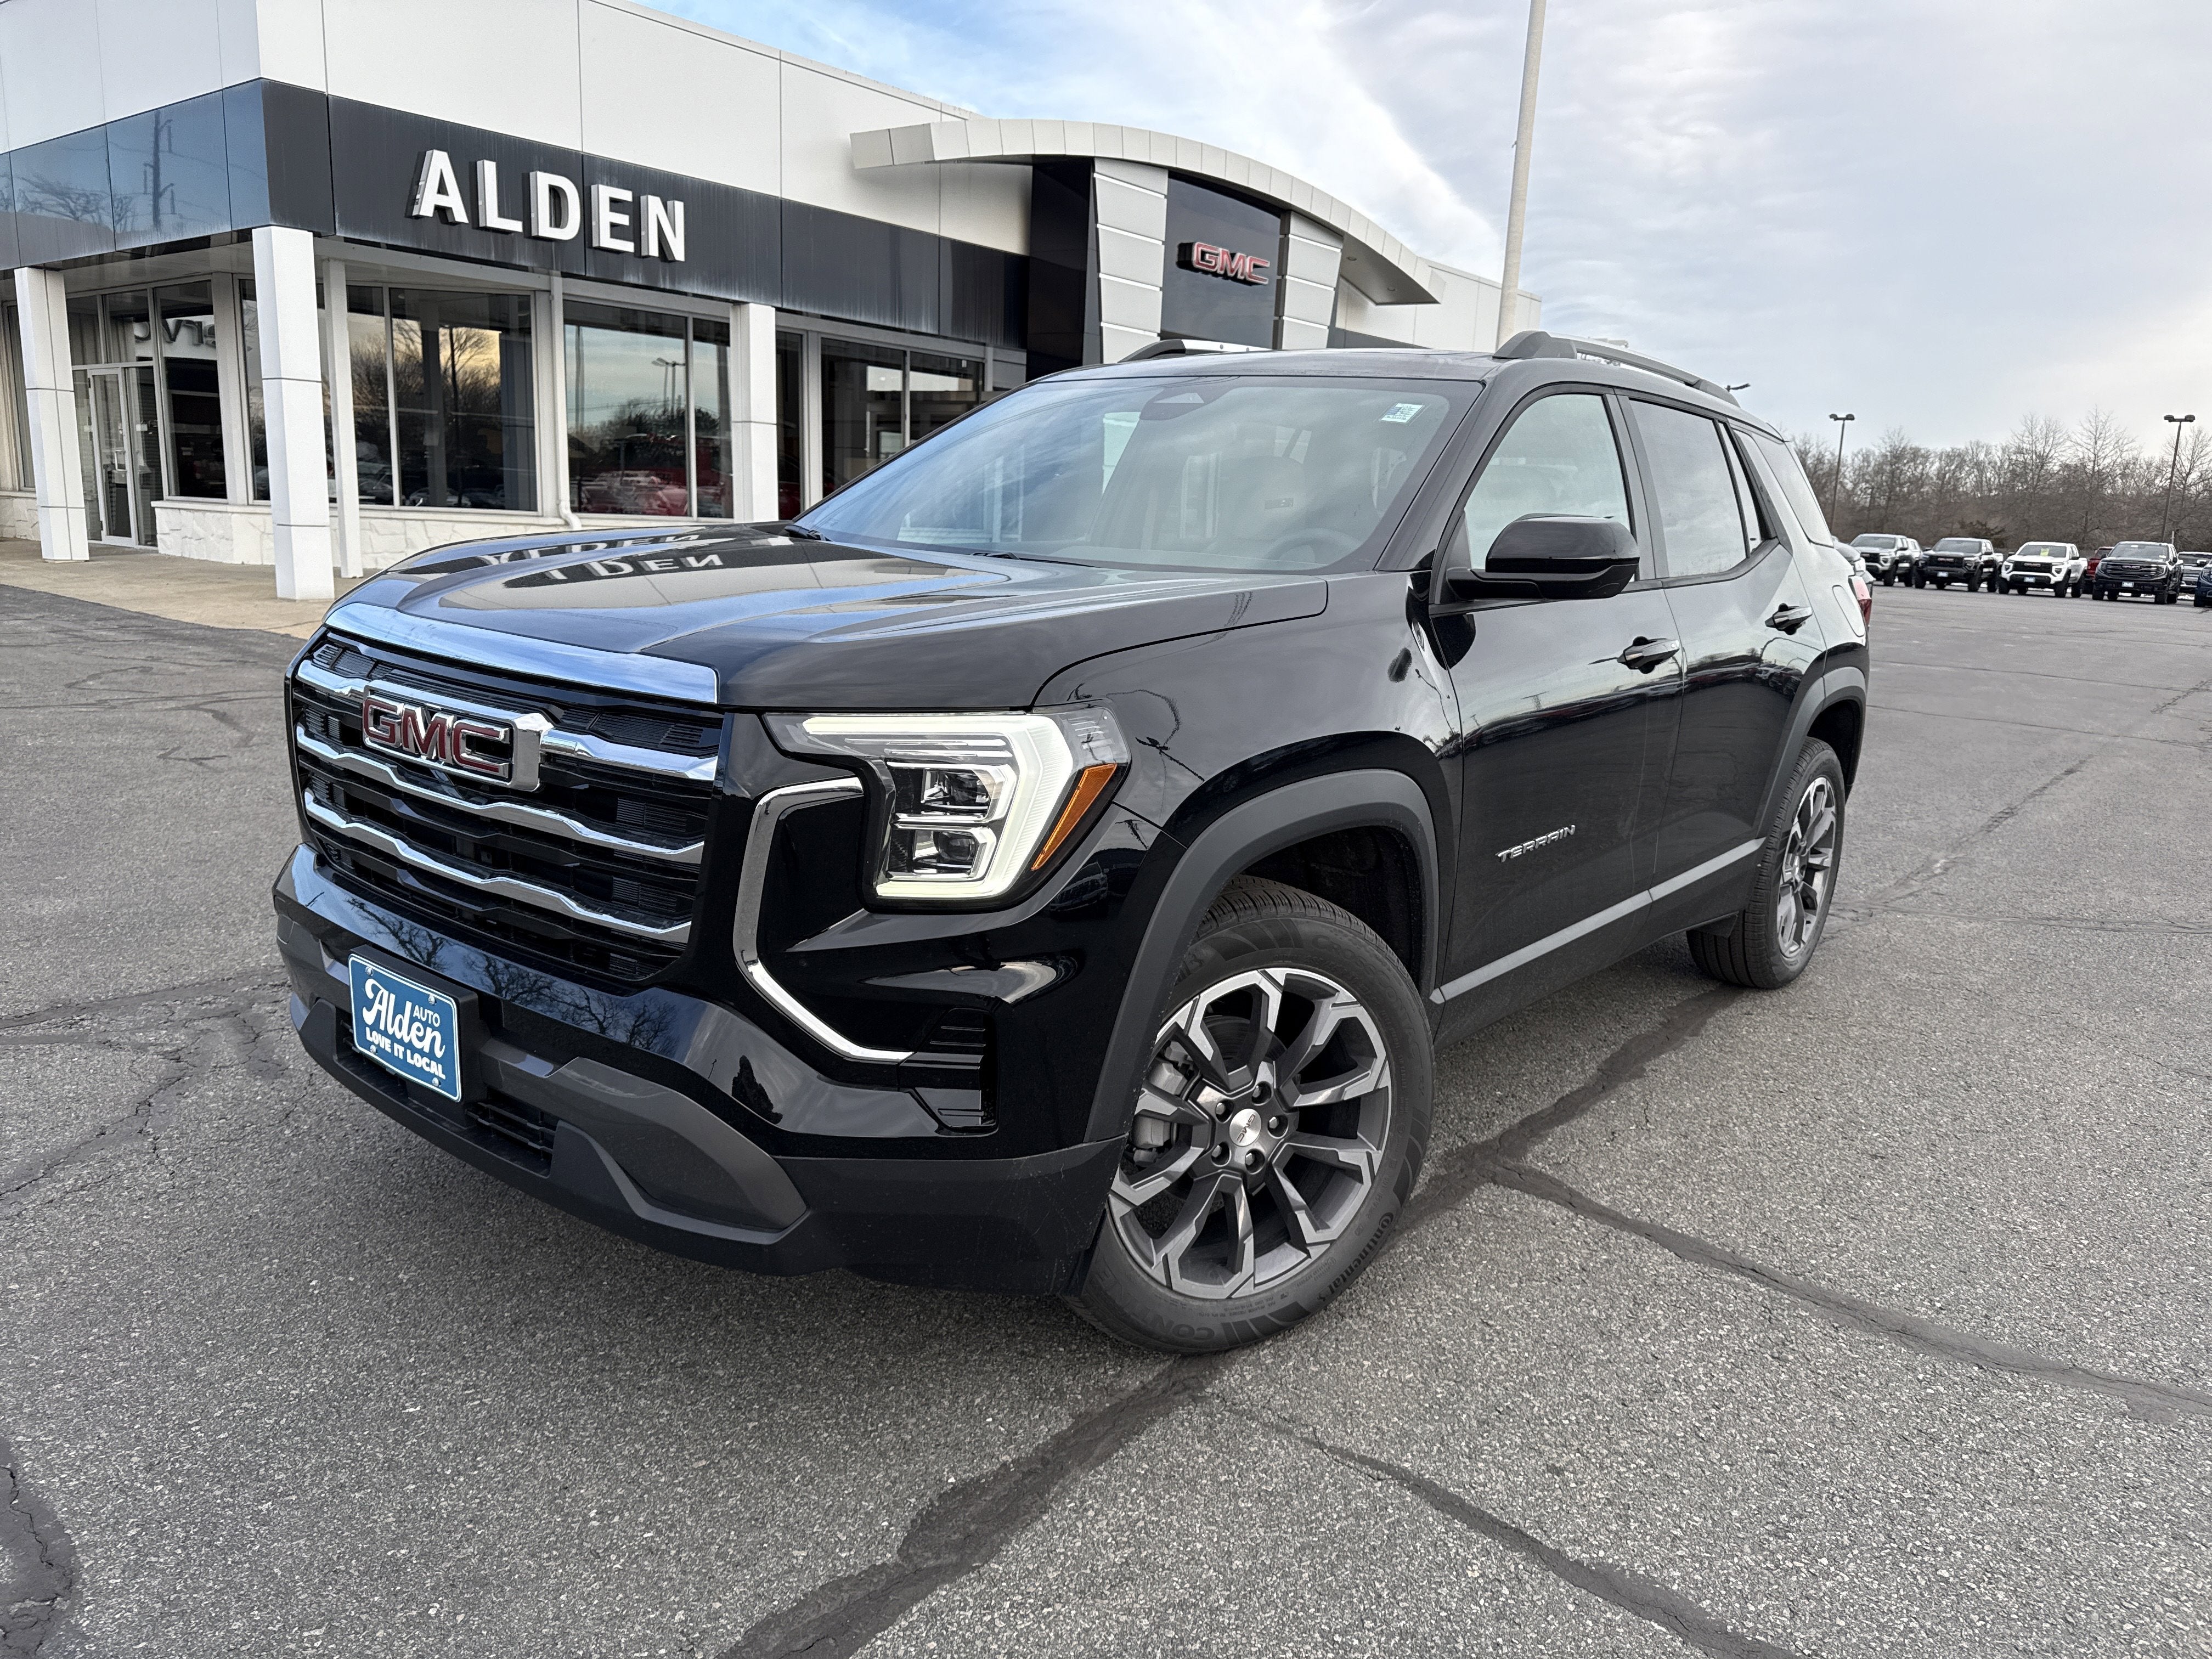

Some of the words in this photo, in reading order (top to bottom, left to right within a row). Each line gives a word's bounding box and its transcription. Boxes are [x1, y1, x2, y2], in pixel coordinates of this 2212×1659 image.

[411, 149, 685, 262] ALDEN
[1192, 241, 1271, 285] GMC
[363, 695, 511, 778] GMC
[1496, 825, 1576, 862] TERRAIN
[363, 978, 445, 1058] Alden
[413, 1005, 441, 1027] AUTO
[365, 1027, 392, 1053] LOVE
[394, 1042, 405, 1060] IT
[407, 1049, 446, 1080] LOCAL
[1237, 1114, 1256, 1143] GMC
[1327, 1212, 1395, 1294] Continental
